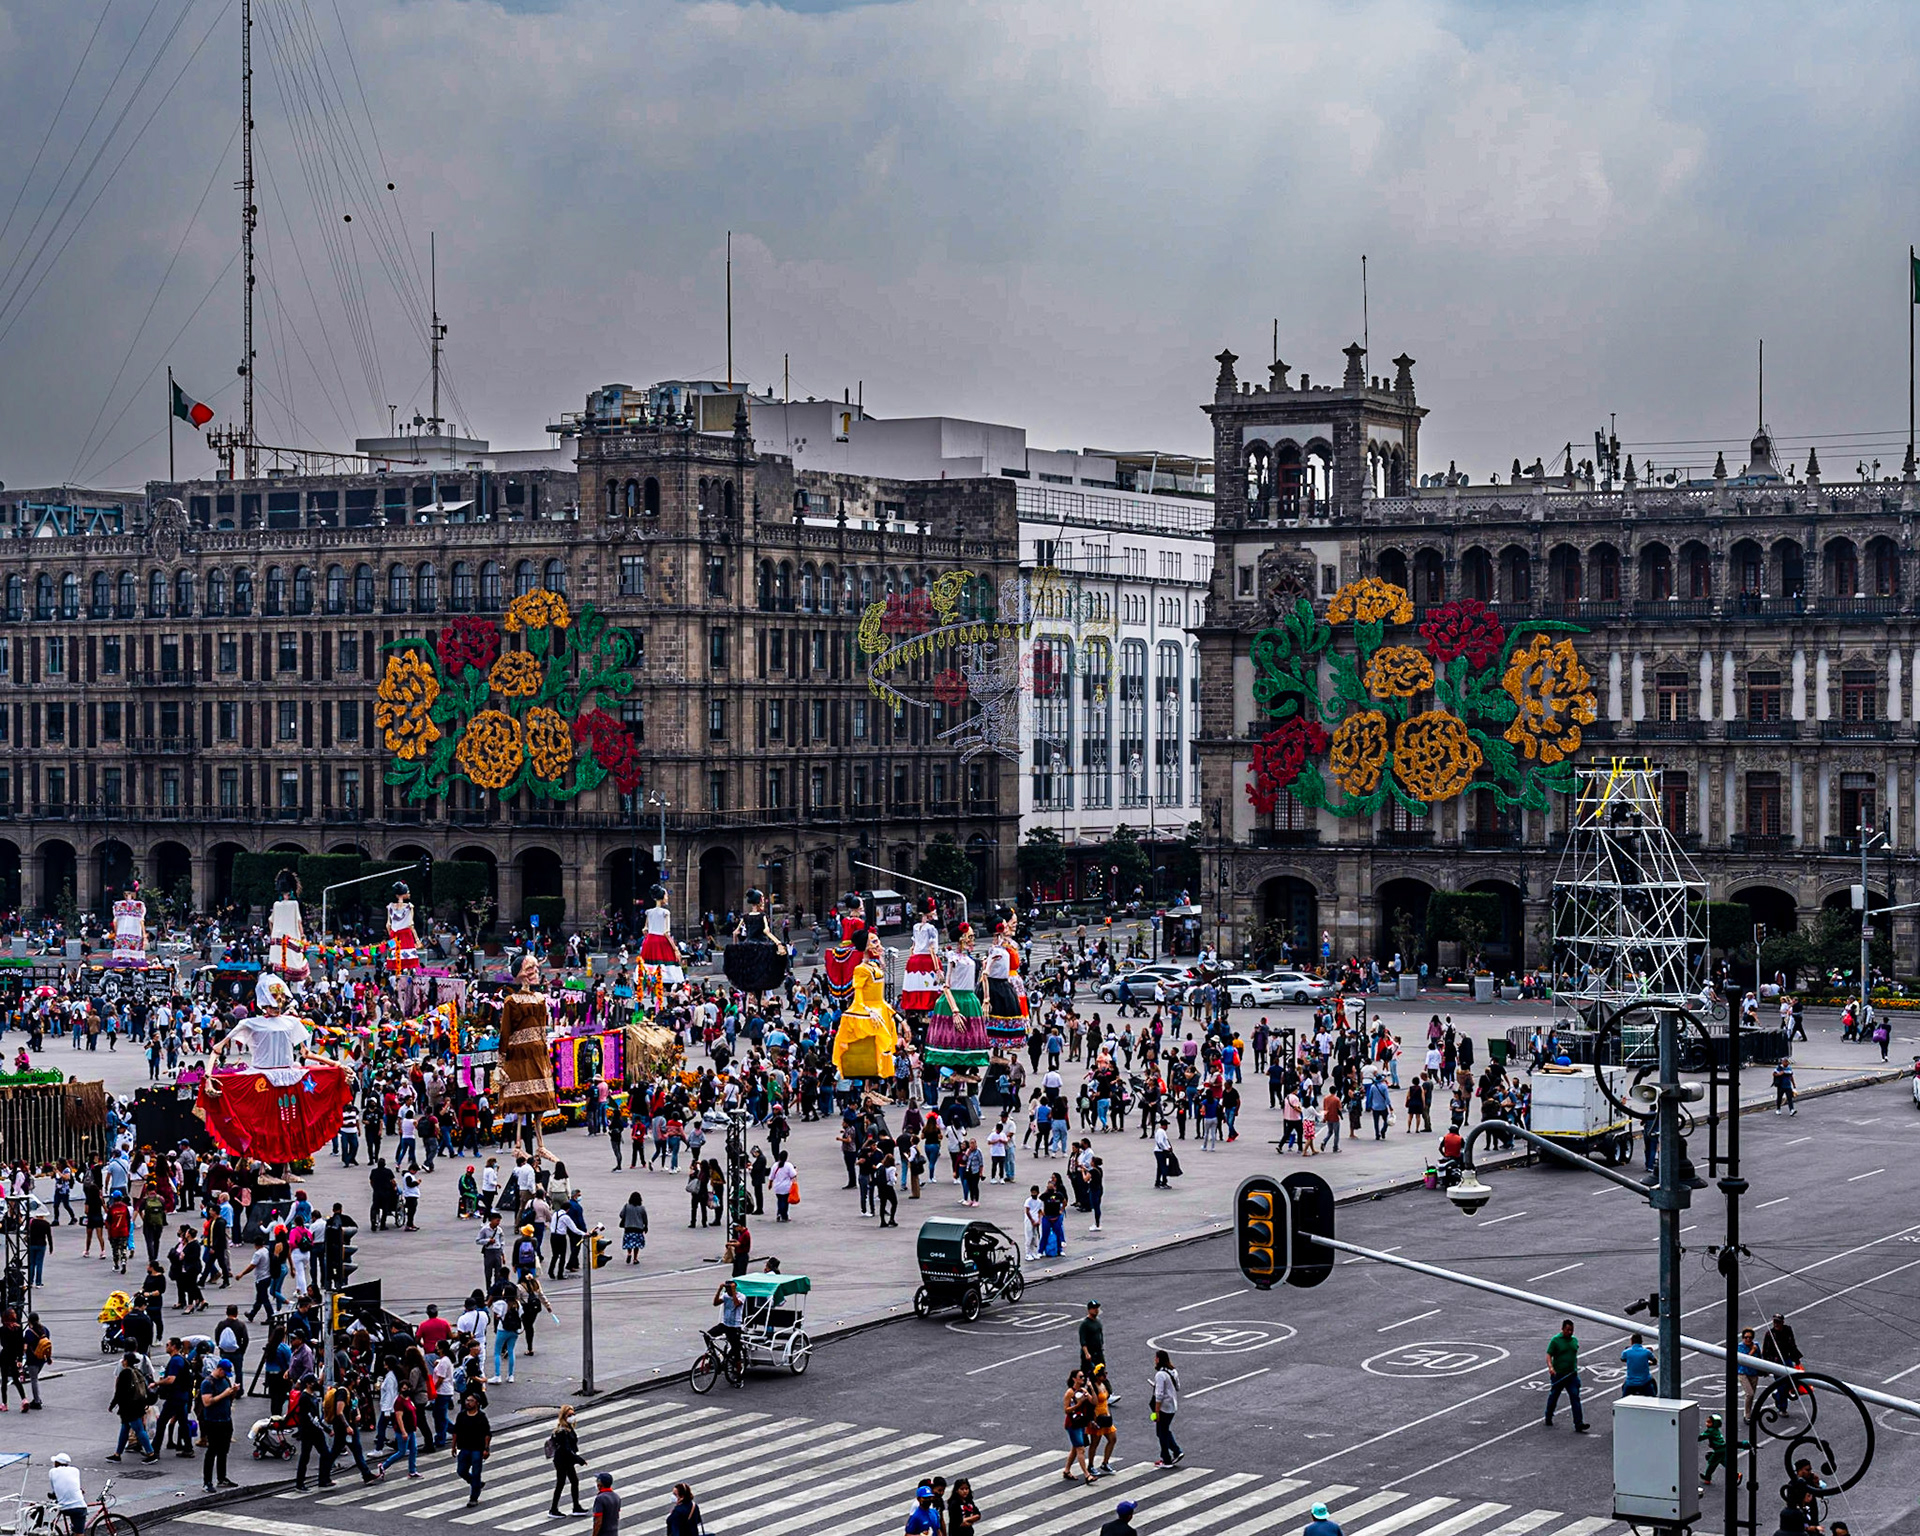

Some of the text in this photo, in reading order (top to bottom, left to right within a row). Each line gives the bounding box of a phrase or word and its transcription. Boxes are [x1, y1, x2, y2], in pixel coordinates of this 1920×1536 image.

[0, 1076, 29, 1084] uintana
[979, 1309, 1072, 1328] 30
[1173, 1326, 1270, 1347] 30
[1386, 1349, 1480, 1370] 30
